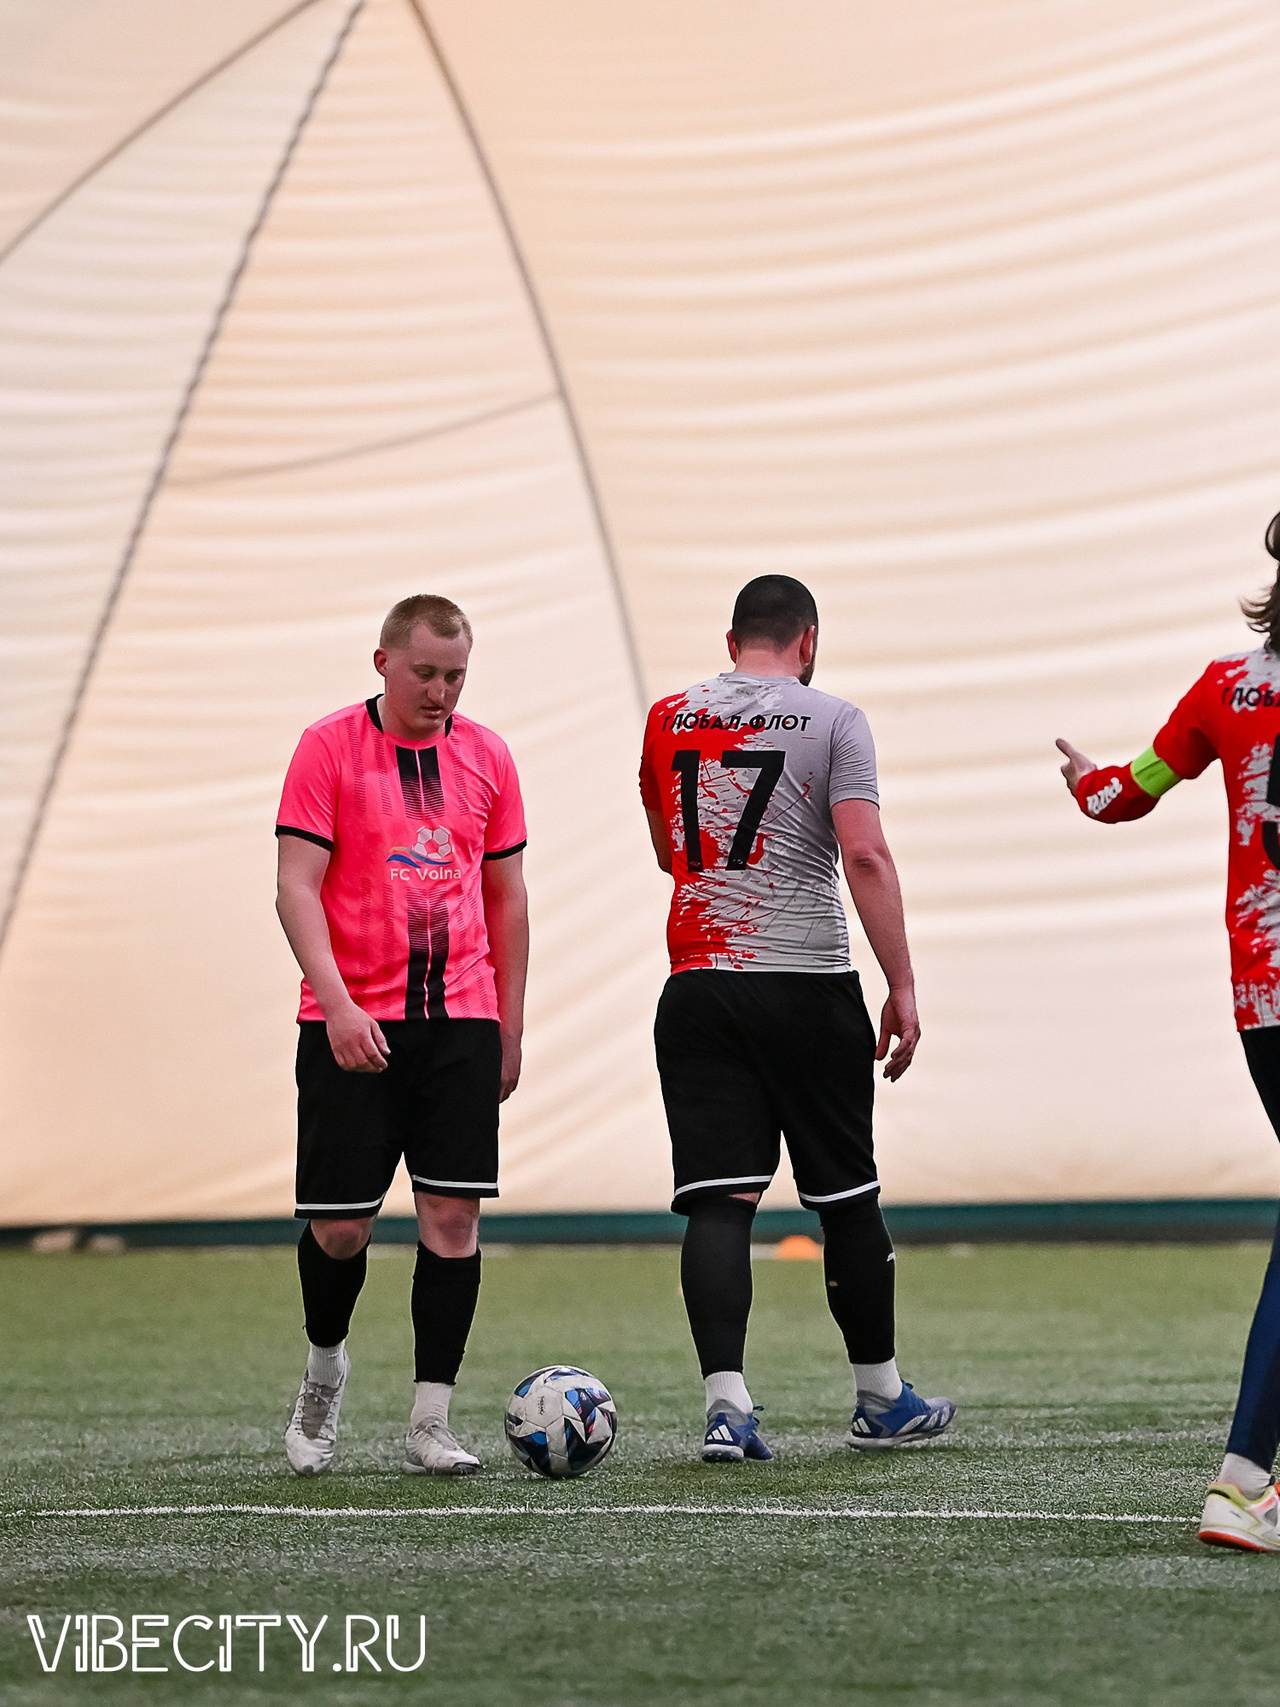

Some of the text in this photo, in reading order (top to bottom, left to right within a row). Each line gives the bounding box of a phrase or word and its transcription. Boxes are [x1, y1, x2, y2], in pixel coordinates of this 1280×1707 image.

[662, 713, 812, 732] ГЛОБАЛ-ФЛОТ
[670, 749, 786, 873] 17
[389, 866, 462, 881] FC Volna
